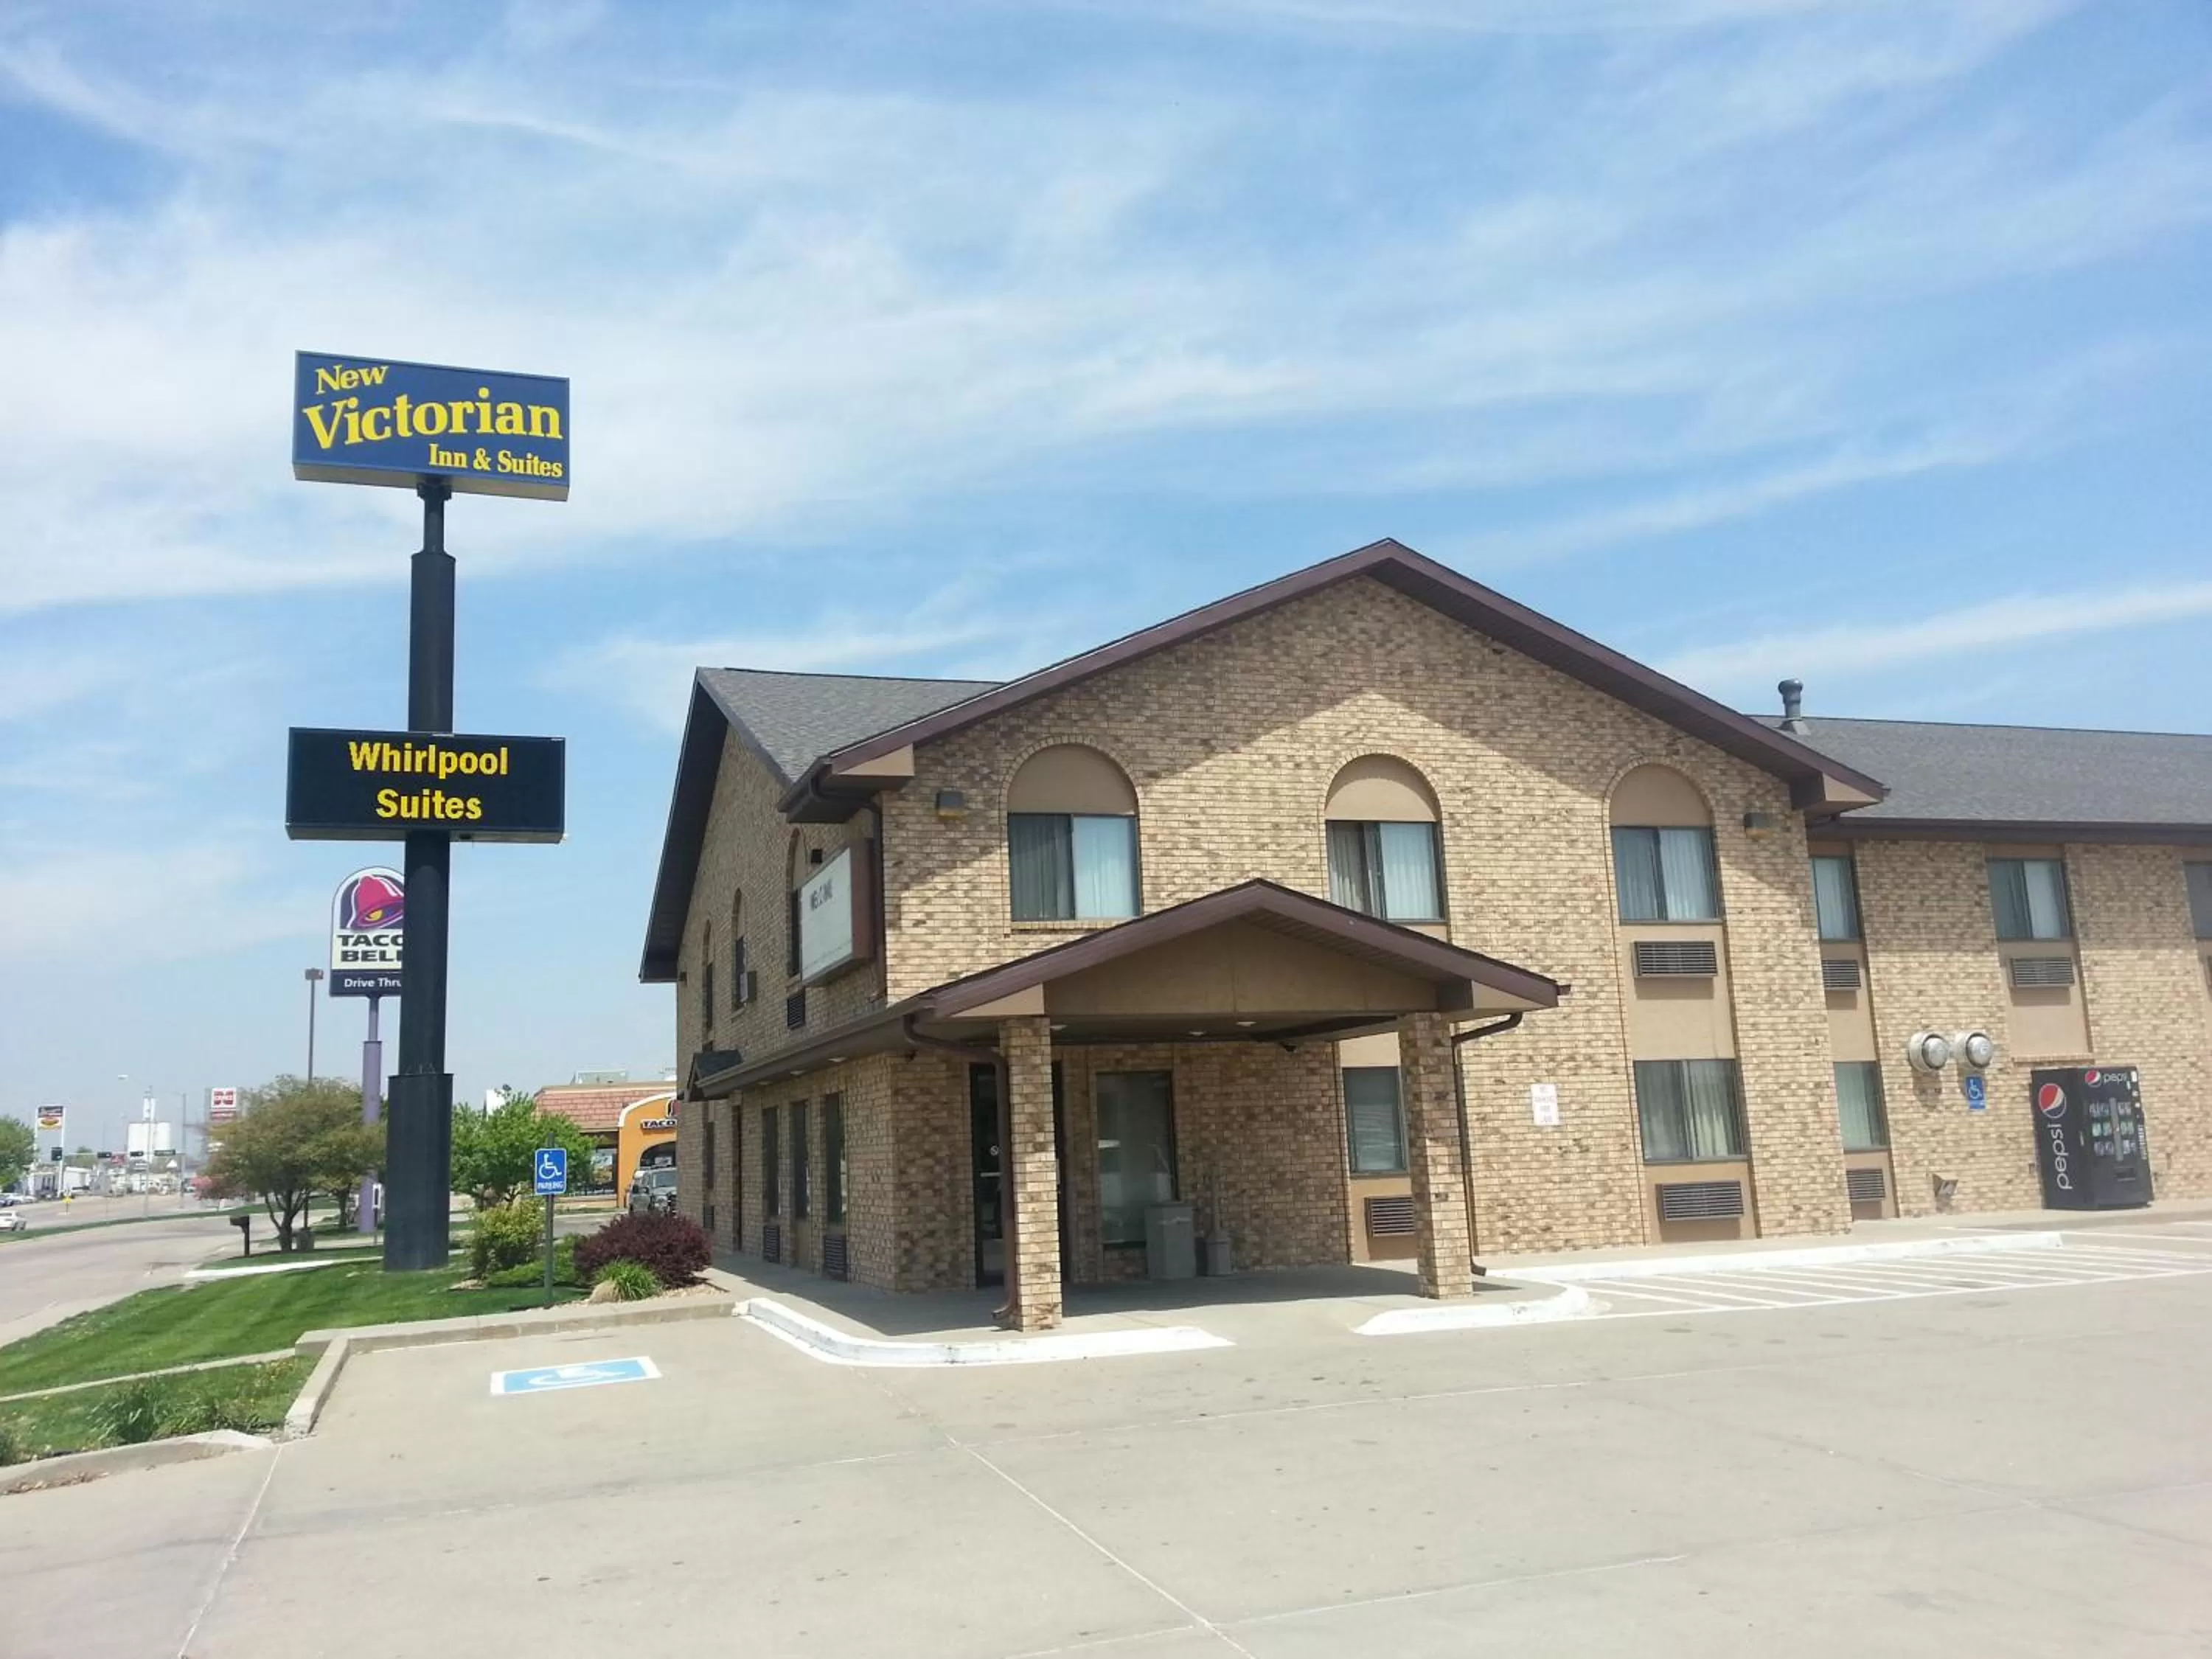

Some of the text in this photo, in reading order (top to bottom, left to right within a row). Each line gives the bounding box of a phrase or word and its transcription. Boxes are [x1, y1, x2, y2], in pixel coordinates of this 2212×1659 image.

[315, 365, 389, 395] New
[302, 387, 563, 449] Victorian
[429, 443, 563, 477] Inn & Suites
[349, 741, 509, 779] Whirlpool
[376, 788, 482, 820] Suites
[344, 977, 375, 987] Drive
[2047, 1124, 2073, 1189] pepsi
